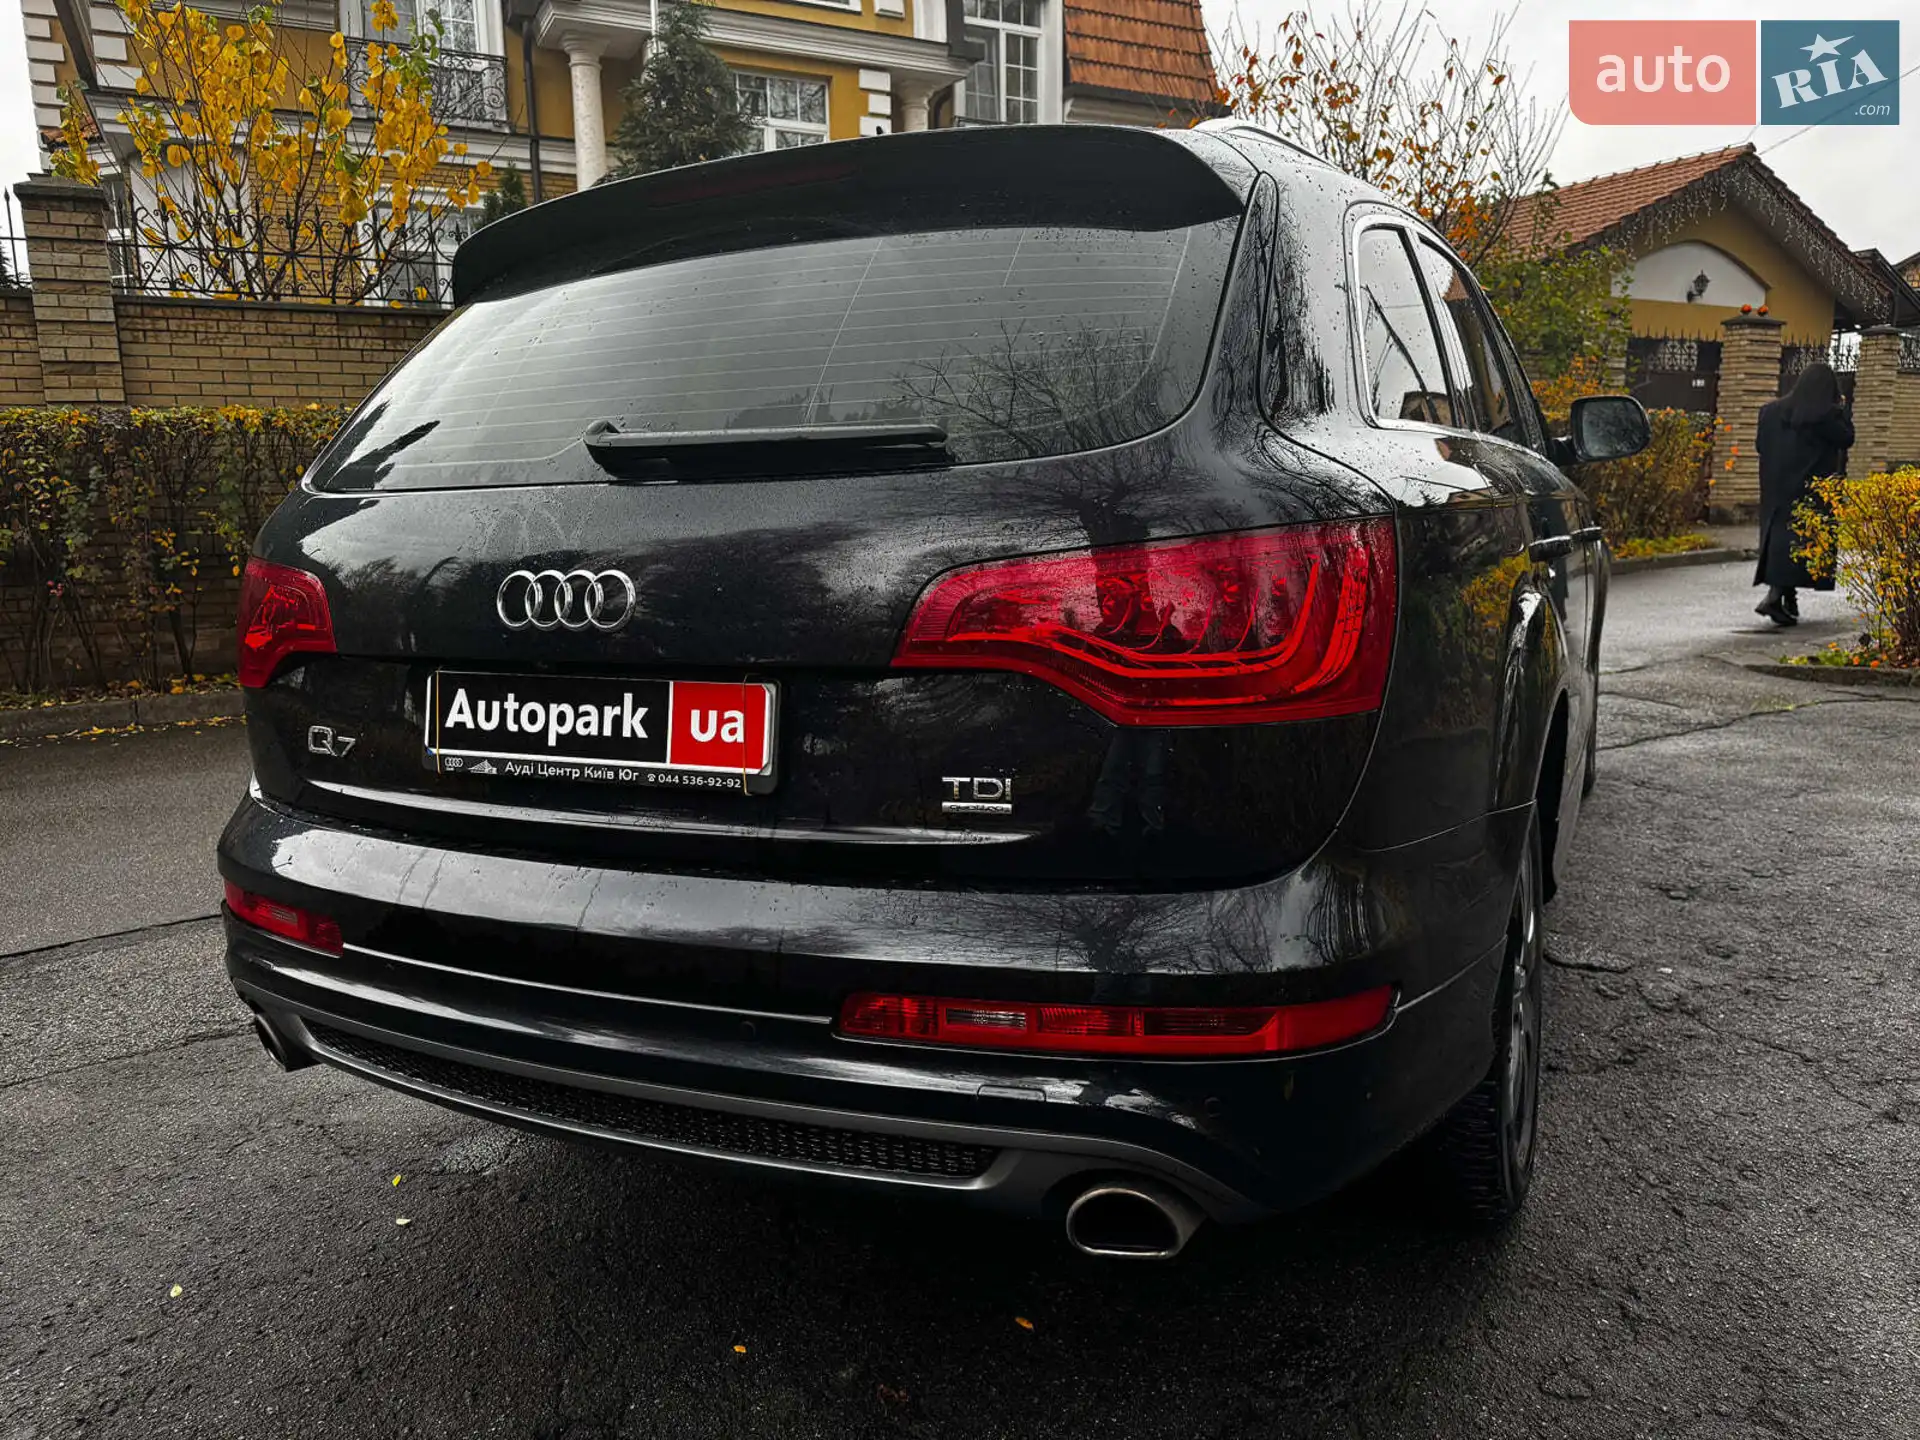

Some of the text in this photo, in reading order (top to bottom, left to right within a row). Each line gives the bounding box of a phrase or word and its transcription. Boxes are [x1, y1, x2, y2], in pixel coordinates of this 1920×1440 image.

[445, 688, 745, 747] Autopark ua
[308, 725, 356, 757] Q7
[504, 761, 741, 788] Ауді Центр Київ Юг 044 536-92-92
[941, 776, 1012, 801] TDI
